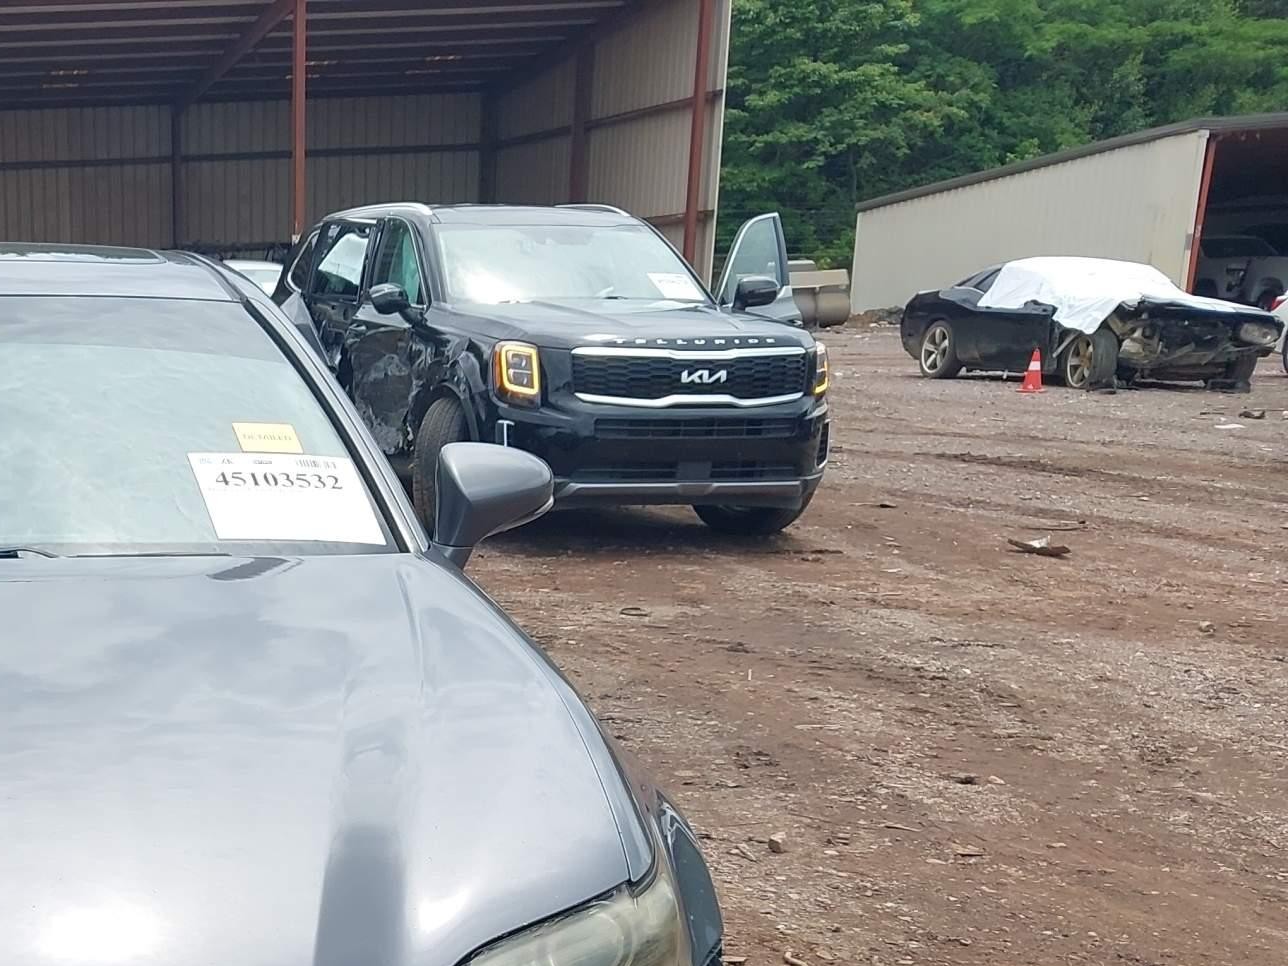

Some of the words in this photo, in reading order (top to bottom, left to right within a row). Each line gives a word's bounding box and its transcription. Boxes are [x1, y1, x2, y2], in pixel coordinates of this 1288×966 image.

[614, 337, 777, 345] TELLURIDE
[680, 369, 728, 384] KIA
[215, 471, 343, 490] 45103532
